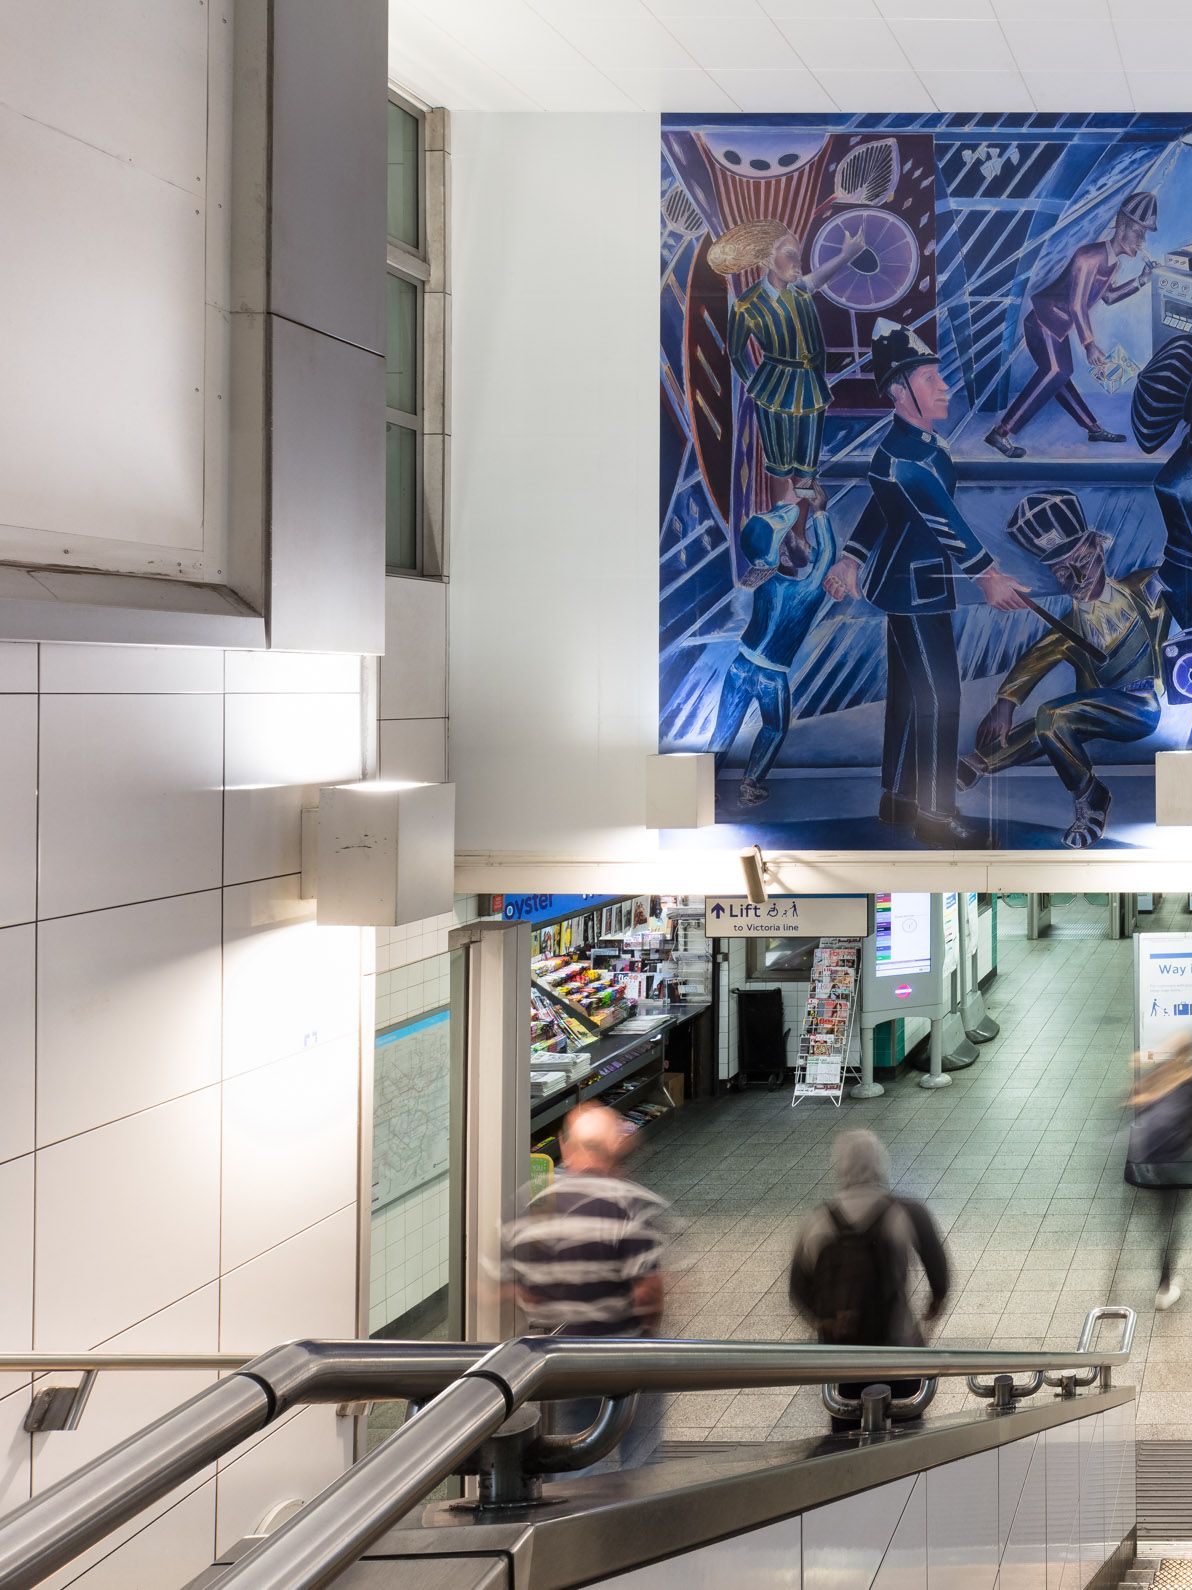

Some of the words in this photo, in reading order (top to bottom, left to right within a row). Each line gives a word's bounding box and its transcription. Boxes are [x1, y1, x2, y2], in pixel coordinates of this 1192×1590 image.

[729, 903, 761, 918] Lift
[733, 924, 743, 932] to
[746, 924, 781, 932] Victoria
[783, 924, 799, 932] line
[1158, 964, 1187, 976] Way
